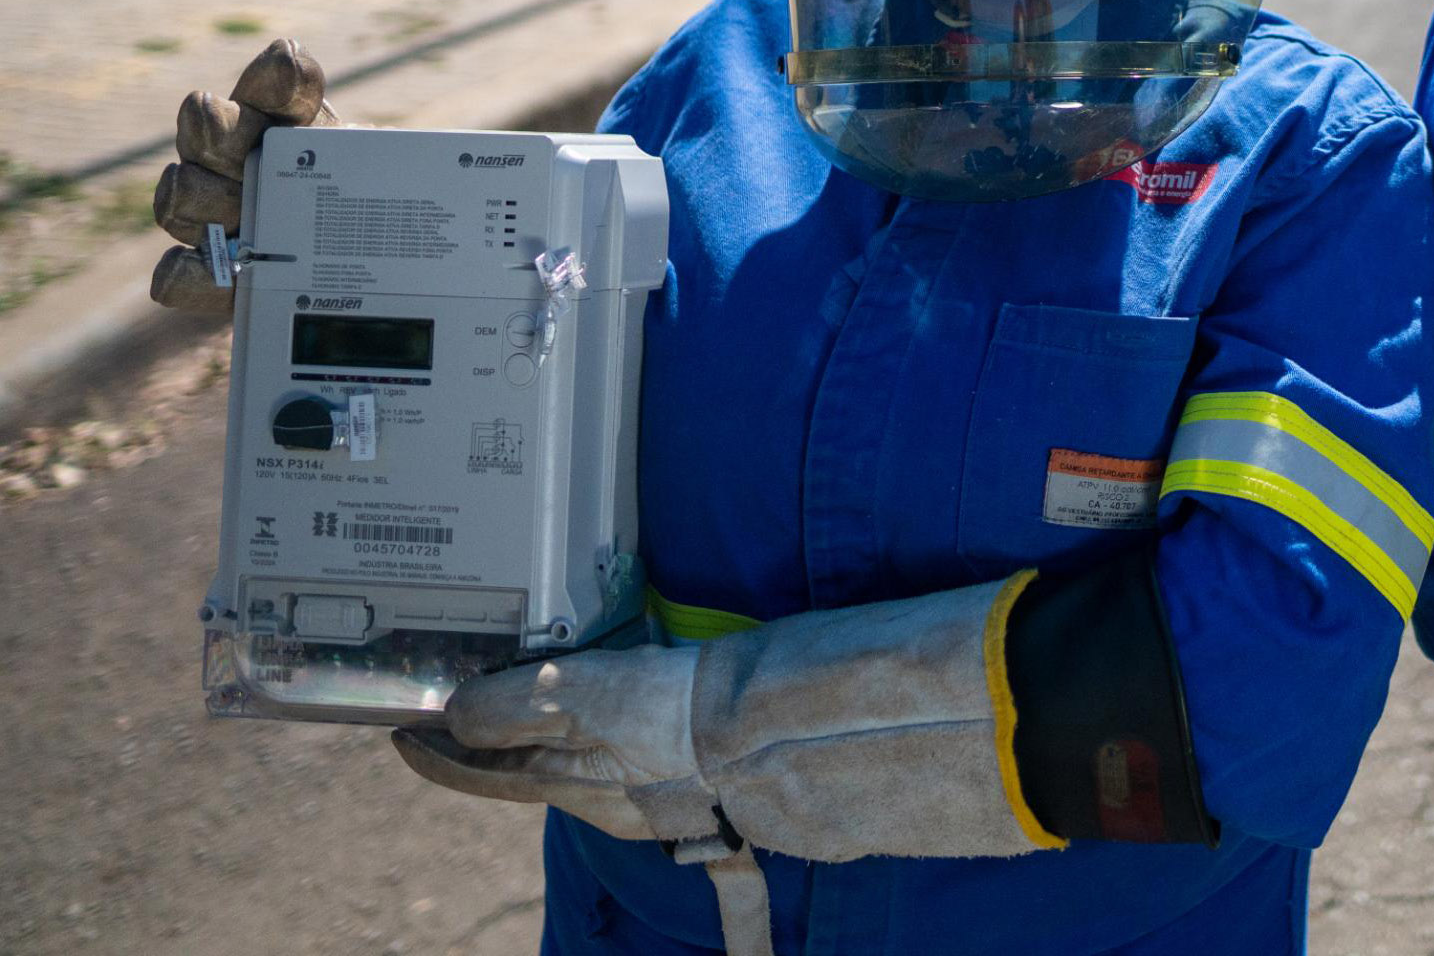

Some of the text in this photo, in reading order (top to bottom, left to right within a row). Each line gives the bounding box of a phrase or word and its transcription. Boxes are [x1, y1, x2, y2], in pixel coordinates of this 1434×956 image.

[475, 155, 525, 167] nansen
[312, 296, 363, 310] nansen
[474, 327, 497, 336] DEM
[472, 367, 495, 376] DISP
[256, 458, 324, 470] NSX P314i
[1088, 500, 1100, 508] CA
[393, 514, 441, 525] INTELIGENTE
[353, 543, 441, 557] 0045704728
